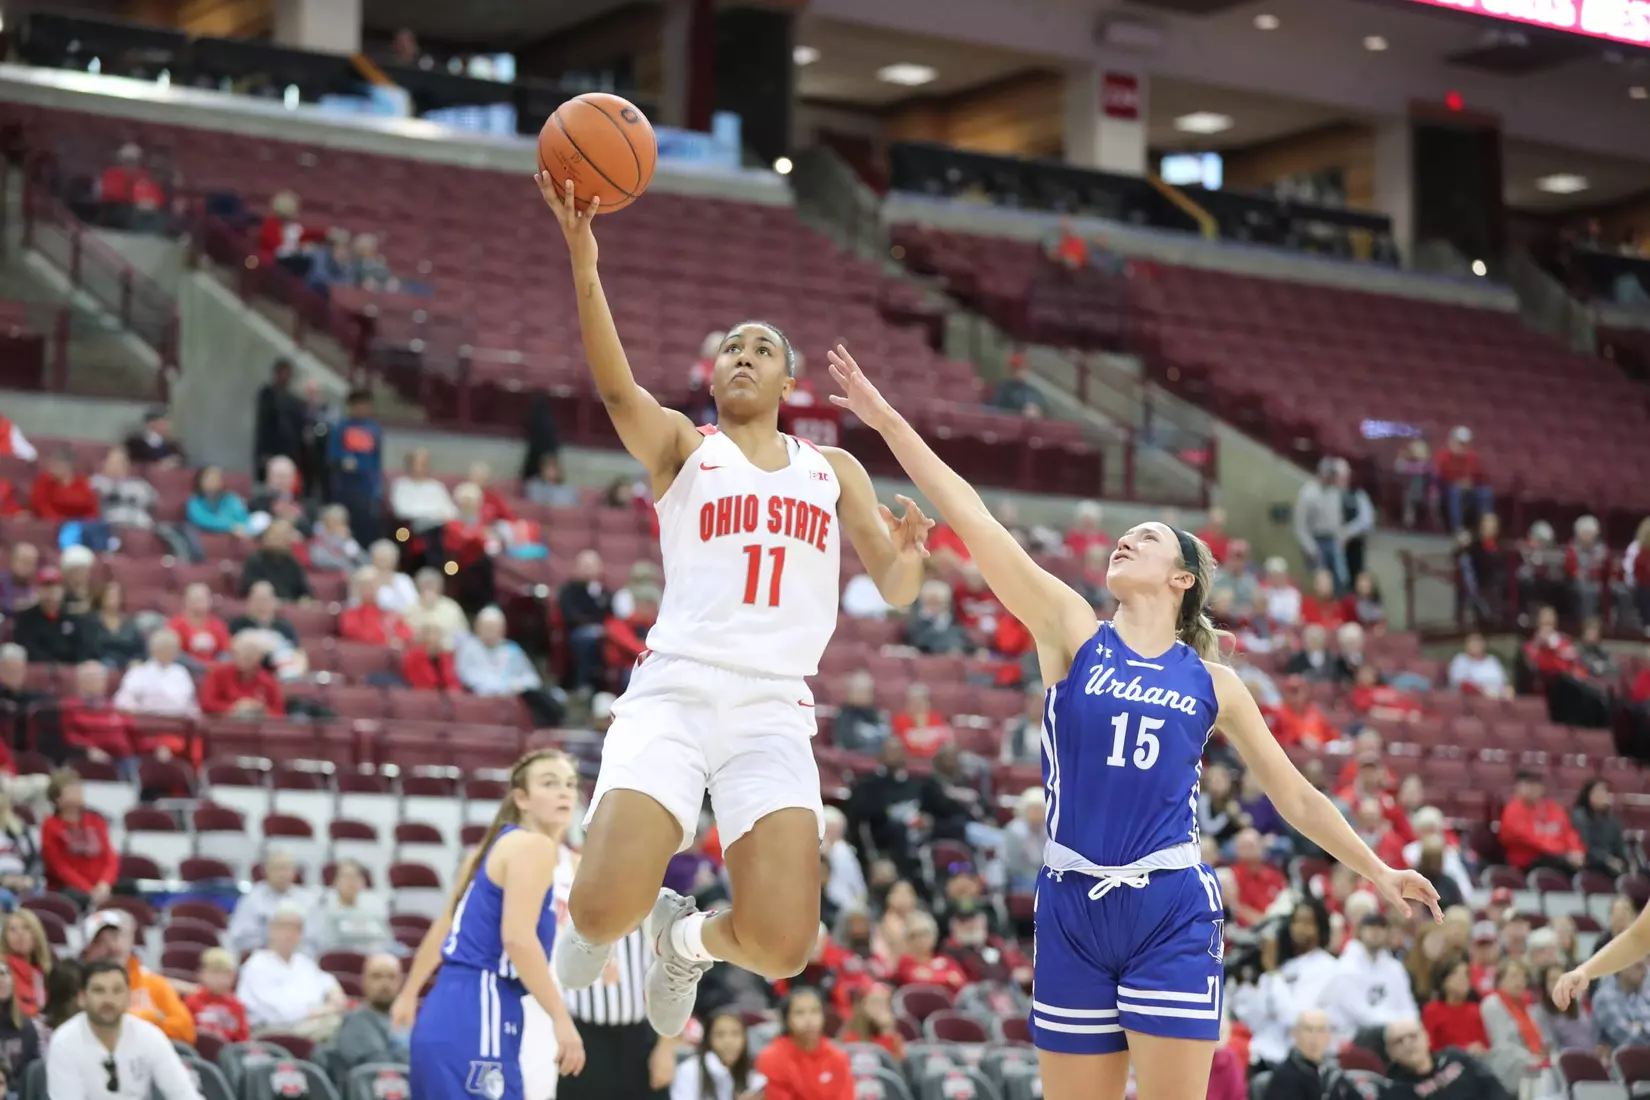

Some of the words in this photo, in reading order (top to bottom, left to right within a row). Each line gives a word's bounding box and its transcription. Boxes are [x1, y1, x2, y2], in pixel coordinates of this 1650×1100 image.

[700, 494, 759, 543] OHIO
[767, 495, 832, 553] STATE
[742, 544, 786, 607] 11
[1084, 664, 1197, 715] Urbana
[1106, 712, 1166, 770] 15
